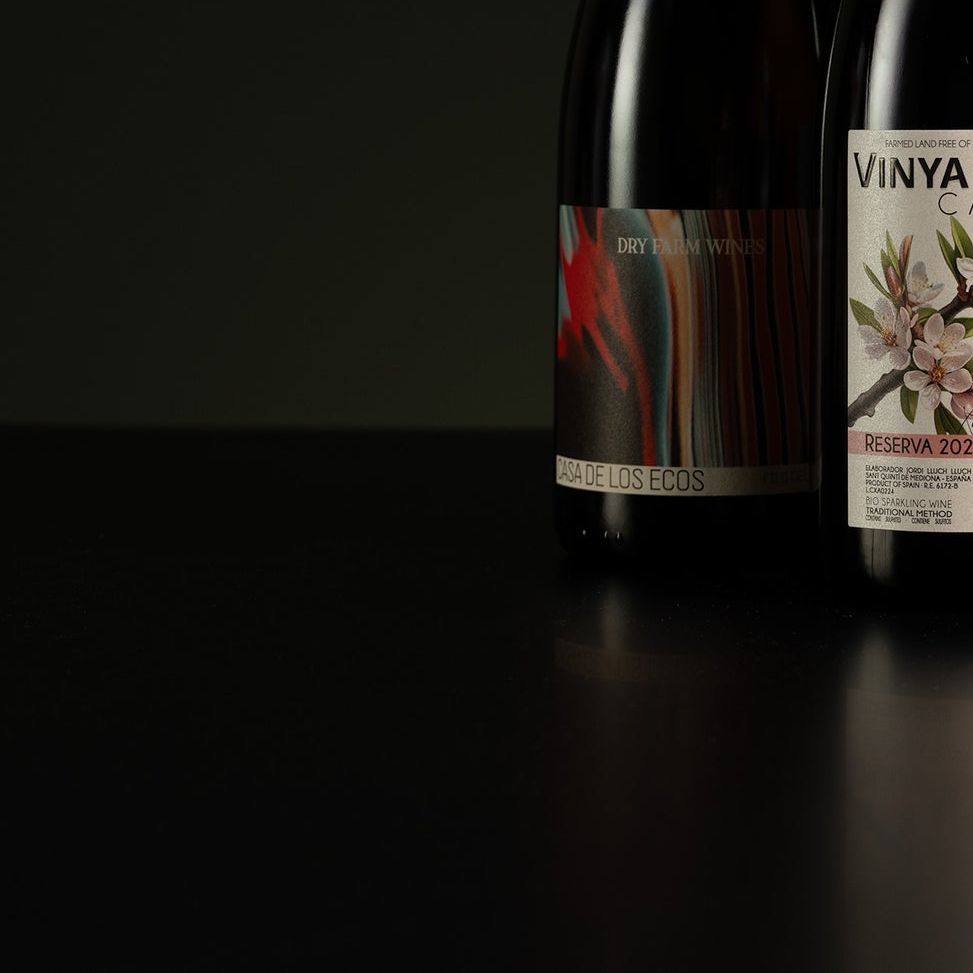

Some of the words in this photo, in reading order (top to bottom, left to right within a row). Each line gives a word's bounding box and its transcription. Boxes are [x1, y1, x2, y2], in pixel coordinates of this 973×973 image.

[885, 139, 914, 148] FARMED
[915, 139, 937, 148] LAND
[938, 139, 957, 148] FREE
[958, 139, 971, 148] OF
[853, 152, 969, 189] VINYA
[617, 237, 648, 254] DRY
[652, 238, 700, 255] FARM
[706, 238, 766, 256] WINES
[865, 434, 932, 454] RESERVA
[558, 457, 582, 484] CASA
[585, 463, 604, 486] DE
[609, 467, 643, 490] LOS
[650, 468, 705, 491] ECOS
[865, 464, 904, 474] ELABORADOR
[906, 467, 924, 475] JORDI
[926, 467, 947, 475] LLUCH
[910, 474, 941, 482] MEDIONA
[945, 474, 972, 482] ESPAÑA
[865, 496, 880, 506] BIO
[881, 497, 926, 509] SPARKLING
[928, 499, 952, 509] WINE
[865, 506, 914, 517] TRADITIONAL
[915, 509, 953, 518] METHOD
